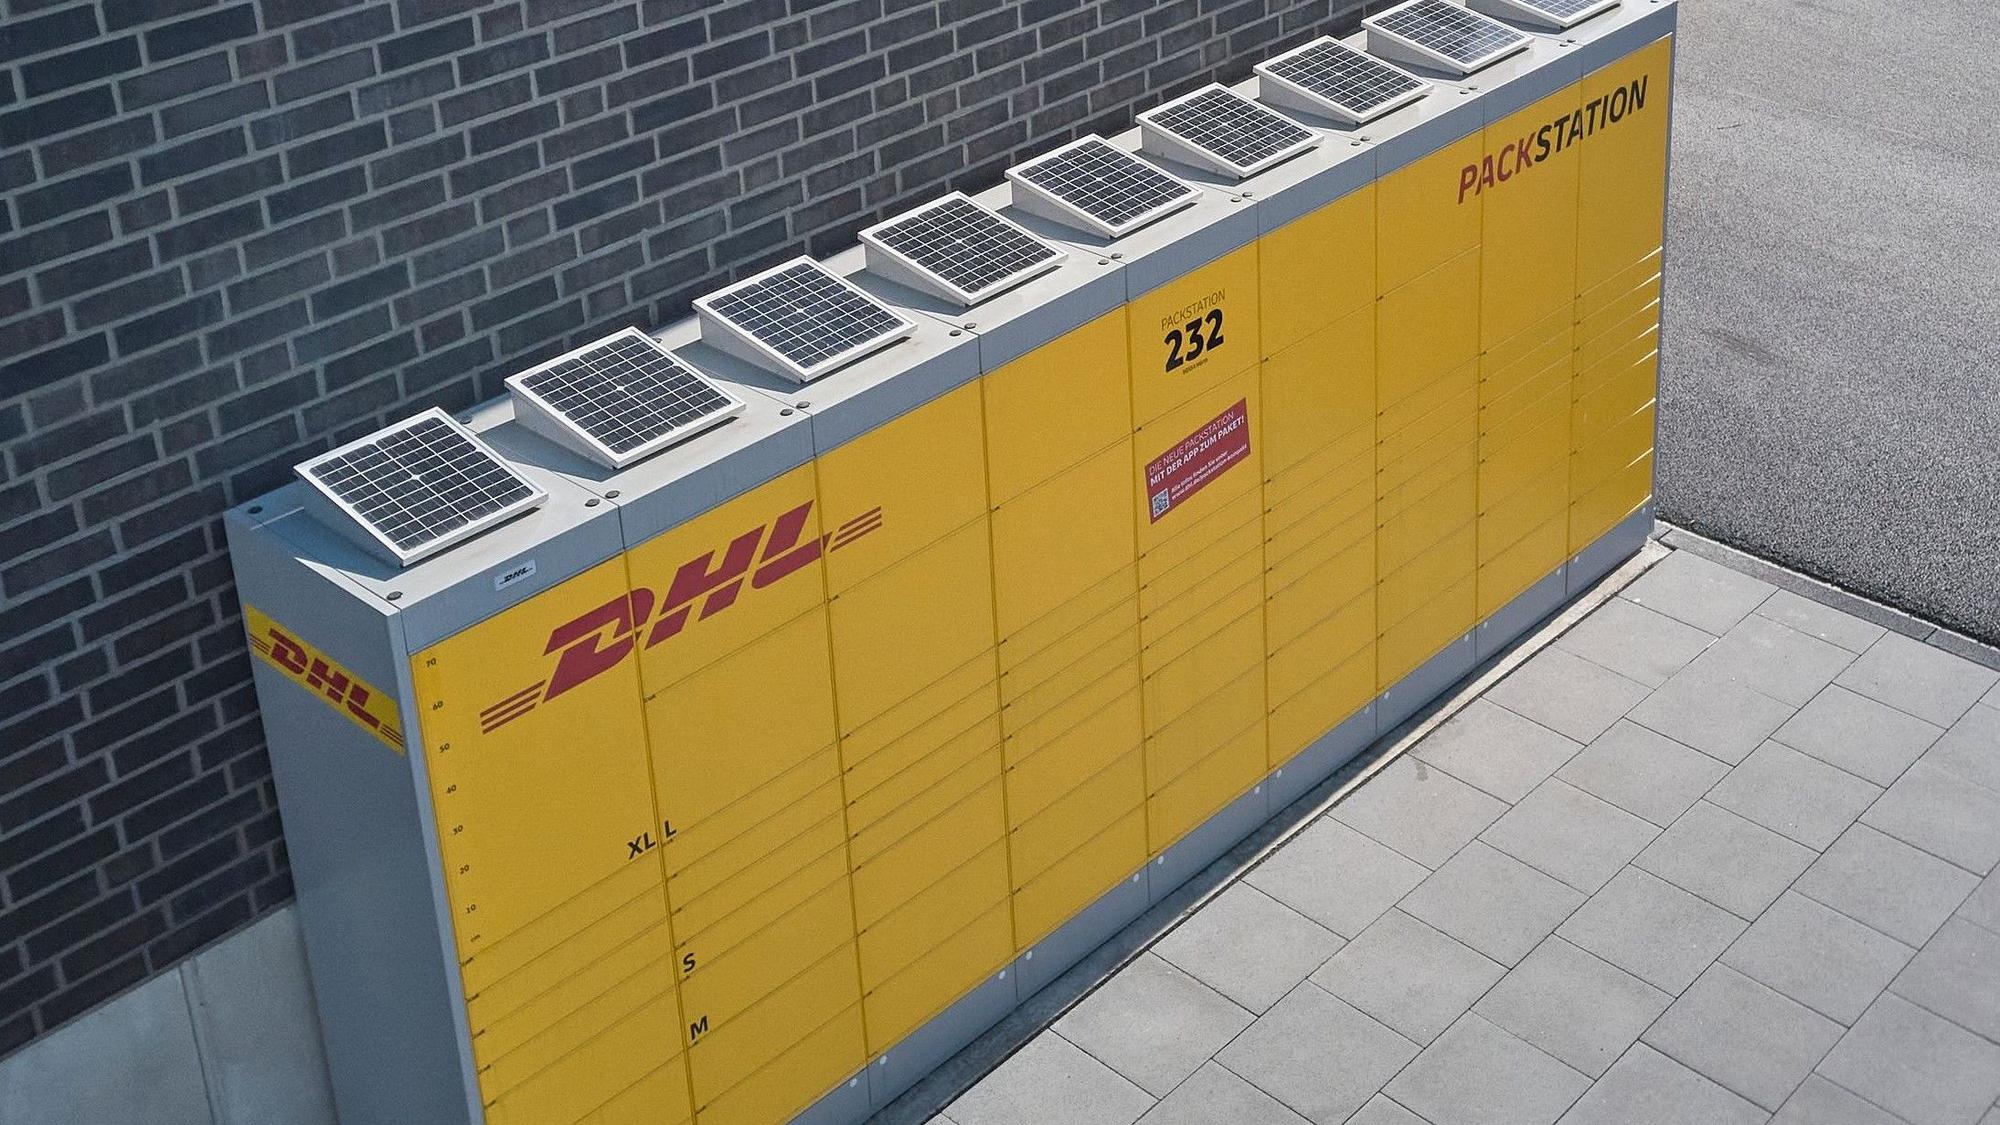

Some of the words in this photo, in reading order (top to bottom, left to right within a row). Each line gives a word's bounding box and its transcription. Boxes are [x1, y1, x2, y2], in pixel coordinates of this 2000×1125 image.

[1458, 75, 1648, 205] PACKSTATION
[1161, 288, 1226, 330] PACKSTATION
[1164, 308, 1224, 373] 232
[1149, 461, 1162, 475] DIE
[1163, 445, 1185, 465] NEUE
[1184, 411, 1234, 450] PACKSTATION
[1150, 469, 1166, 487] MIT
[1166, 458, 1183, 475] DER
[1183, 447, 1200, 464] APP
[1199, 433, 1217, 452] ZUM
[1217, 415, 1245, 440] PAKET!
[503, 566, 529, 582] DHL
[541, 499, 834, 704] DHL
[426, 658, 436, 667] 70
[268, 627, 382, 730] DHL
[433, 701, 443, 711] 60
[440, 743, 450, 753] 50
[446, 785, 456, 794] 40
[453, 825, 463, 835] 30
[664, 820, 677, 838] L
[627, 831, 656, 860] XL
[460, 865, 469, 875] 20
[466, 904, 476, 914] 10
[683, 952, 696, 973] S
[690, 1015, 708, 1040] M
